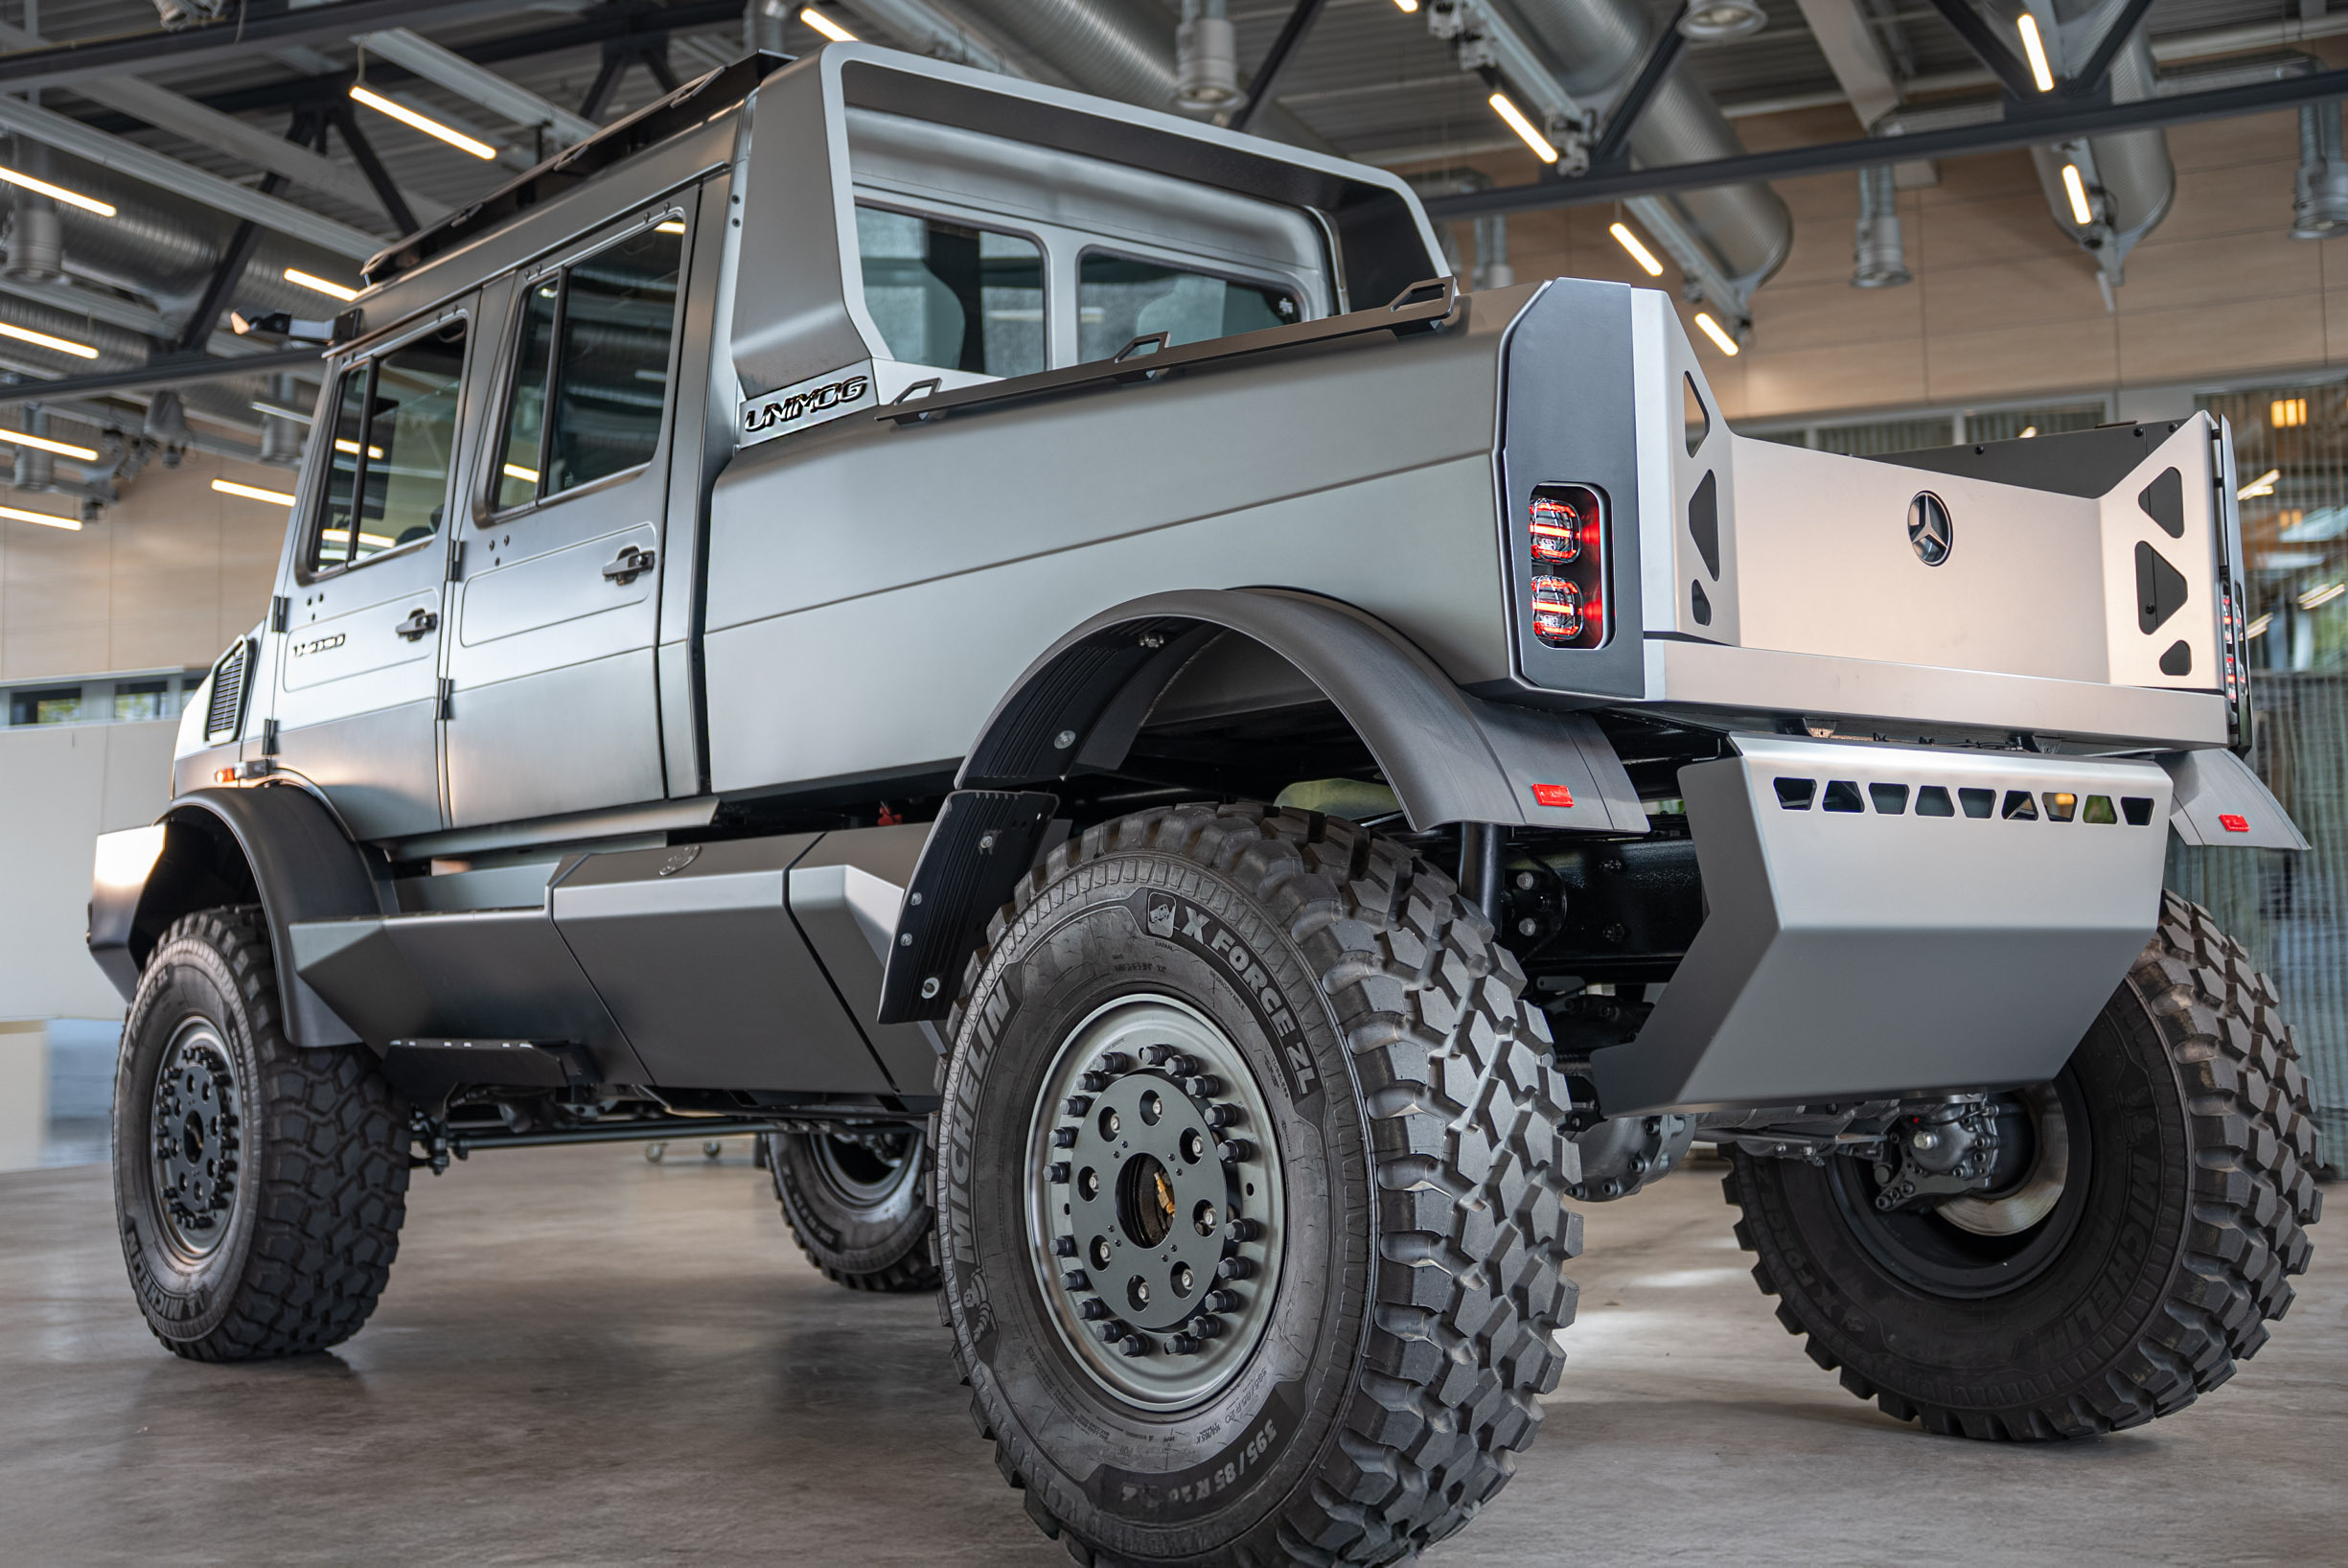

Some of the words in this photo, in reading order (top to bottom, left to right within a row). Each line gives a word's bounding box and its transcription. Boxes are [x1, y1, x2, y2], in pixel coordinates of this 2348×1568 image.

[744, 375, 867, 431] UNIMOG
[1182, 906, 1209, 944] X
[1210, 928, 1296, 1037] FORCE
[1286, 1042, 1316, 1095] ZL
[949, 974, 1010, 1264] MICHELIN
[126, 1232, 185, 1320] MICHELIN
[2037, 1151, 2158, 1366] MICHELIN
